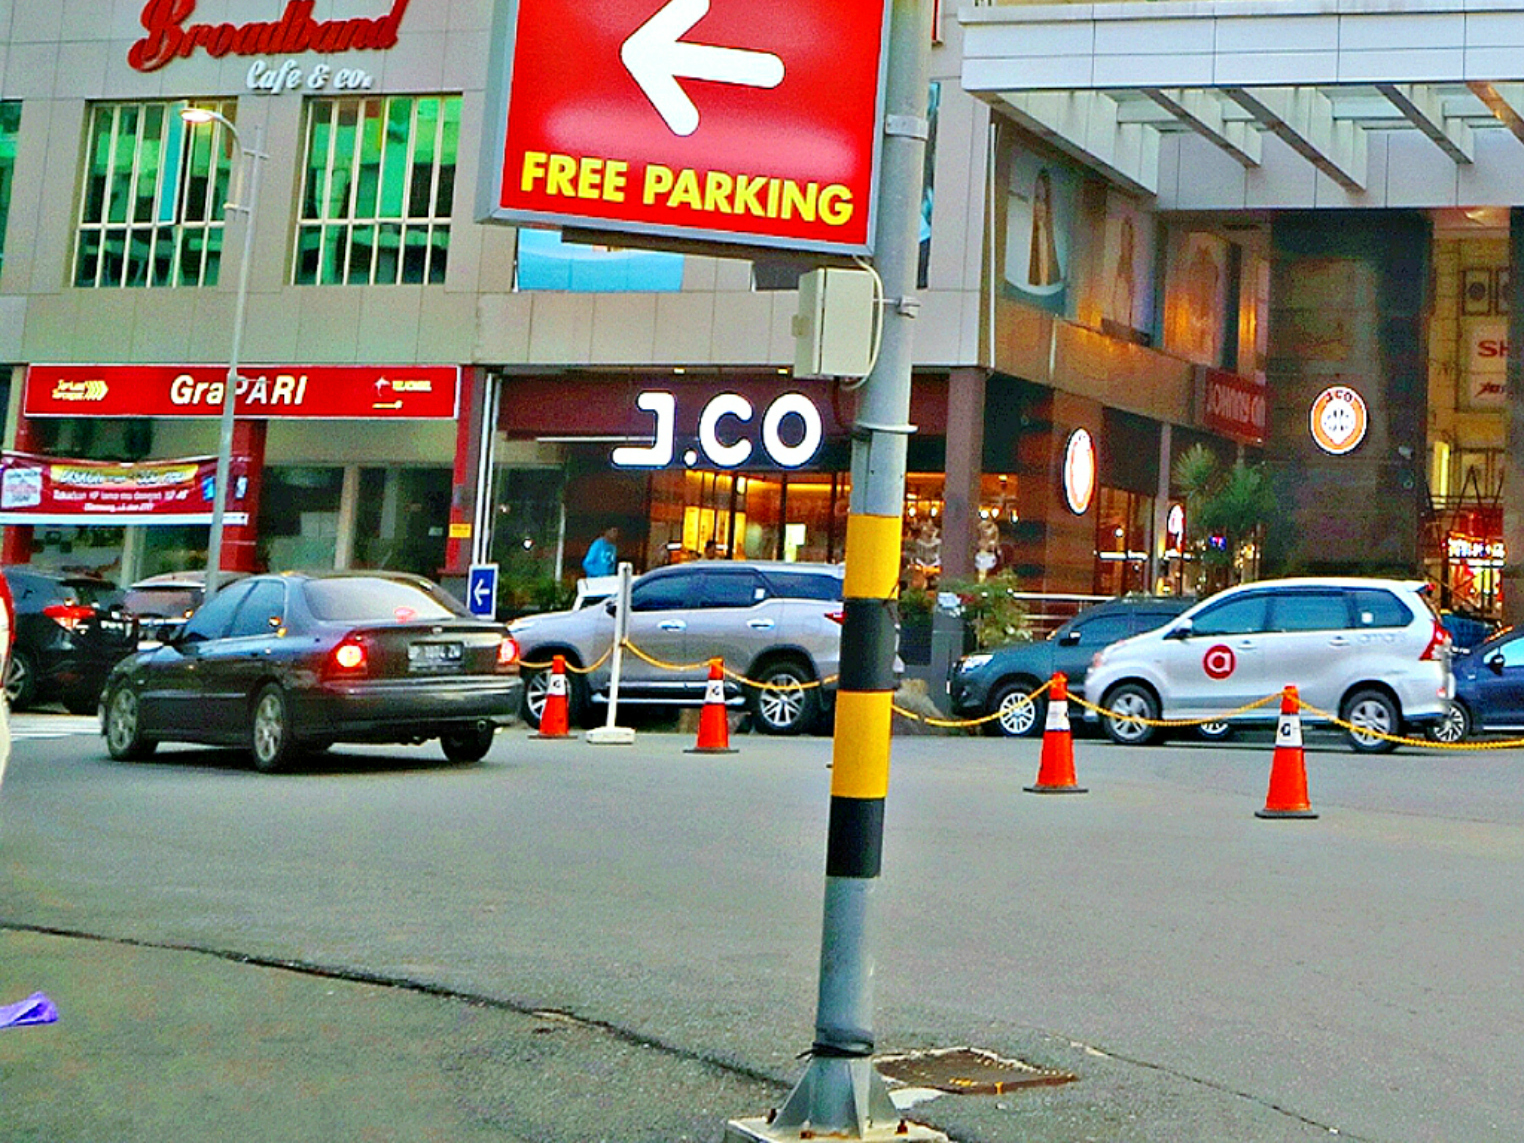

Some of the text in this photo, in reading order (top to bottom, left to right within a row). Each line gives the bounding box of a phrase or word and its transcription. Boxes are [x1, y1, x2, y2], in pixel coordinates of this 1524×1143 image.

[246, 59, 303, 95] Cafe
[306, 63, 331, 90] &
[520, 151, 855, 226] FREE PARKING
[170, 373, 309, 407] GraPARI
[612, 390, 824, 468] J.CO
